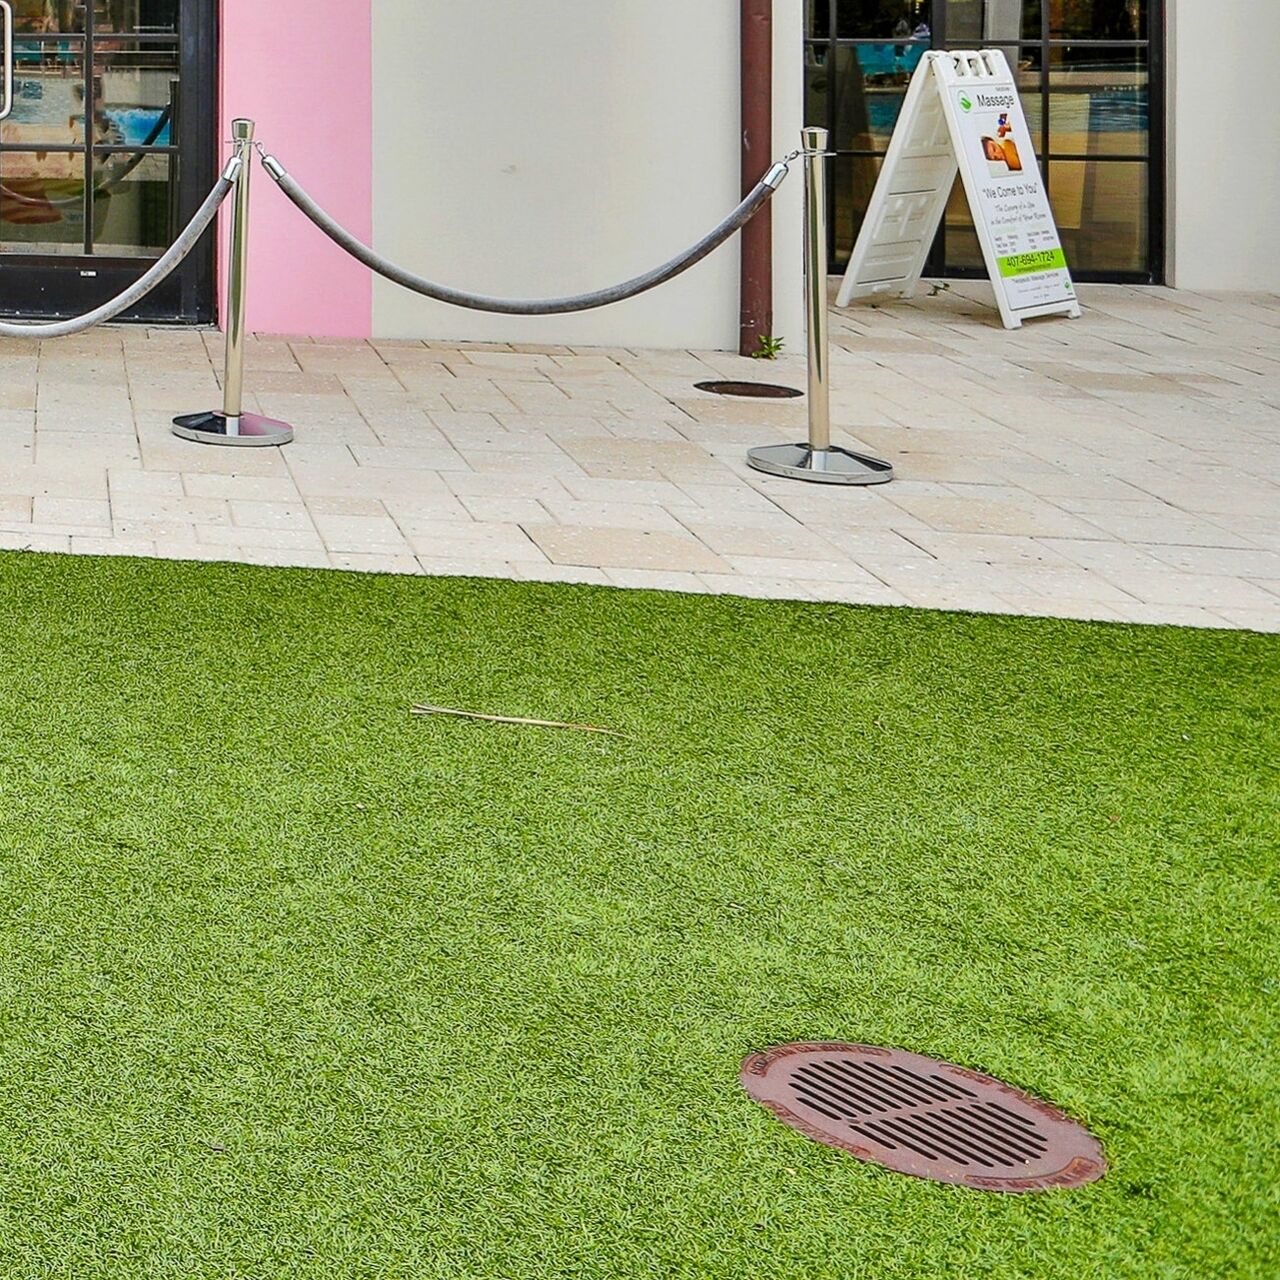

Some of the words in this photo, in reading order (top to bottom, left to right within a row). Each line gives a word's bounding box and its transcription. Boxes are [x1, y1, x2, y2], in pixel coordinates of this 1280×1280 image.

[977, 94, 1015, 109] Massage
[997, 186, 1017, 198] Come
[1017, 185, 1024, 195] to
[1007, 251, 1055, 267] 407-694-1724
